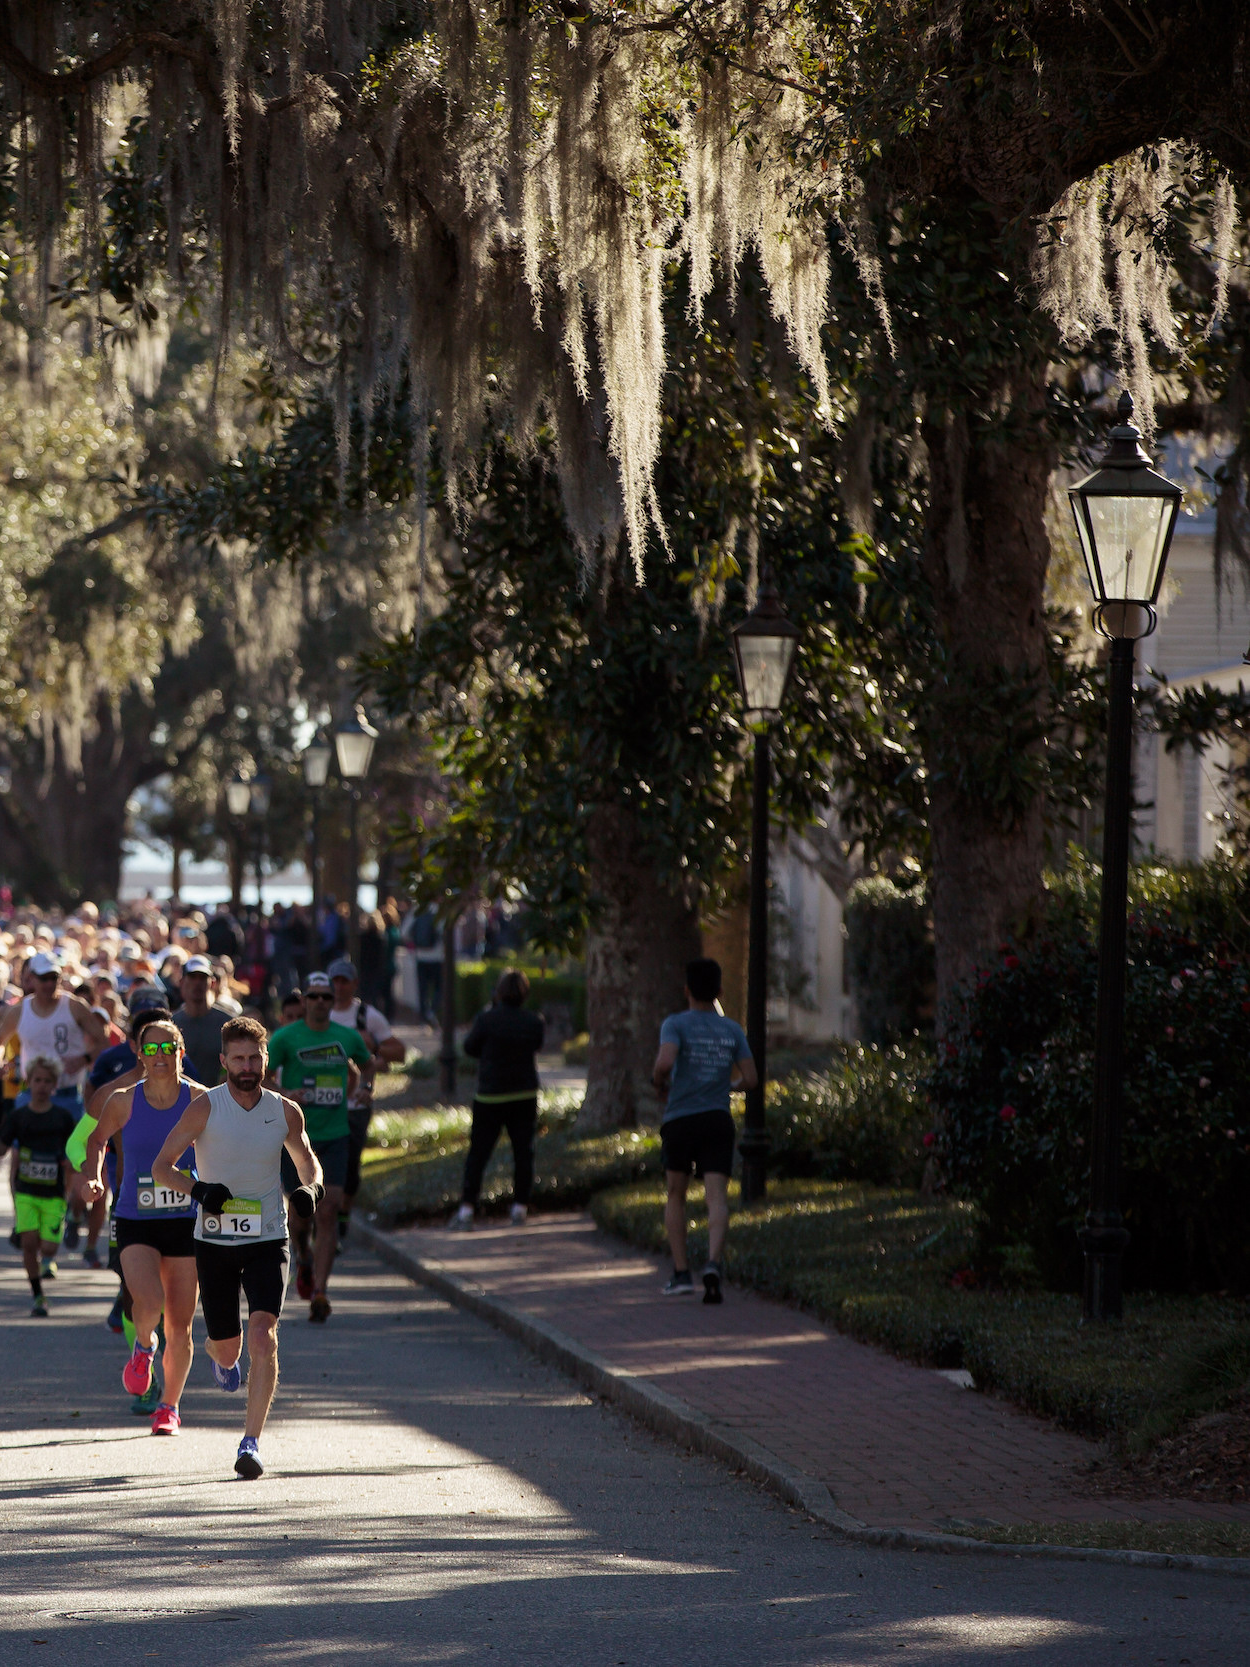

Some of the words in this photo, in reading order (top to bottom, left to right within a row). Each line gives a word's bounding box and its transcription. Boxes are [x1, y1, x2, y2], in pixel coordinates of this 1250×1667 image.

[317, 1090, 343, 1101] 206
[160, 1190, 186, 1204] 119
[230, 1218, 251, 1232] 16
